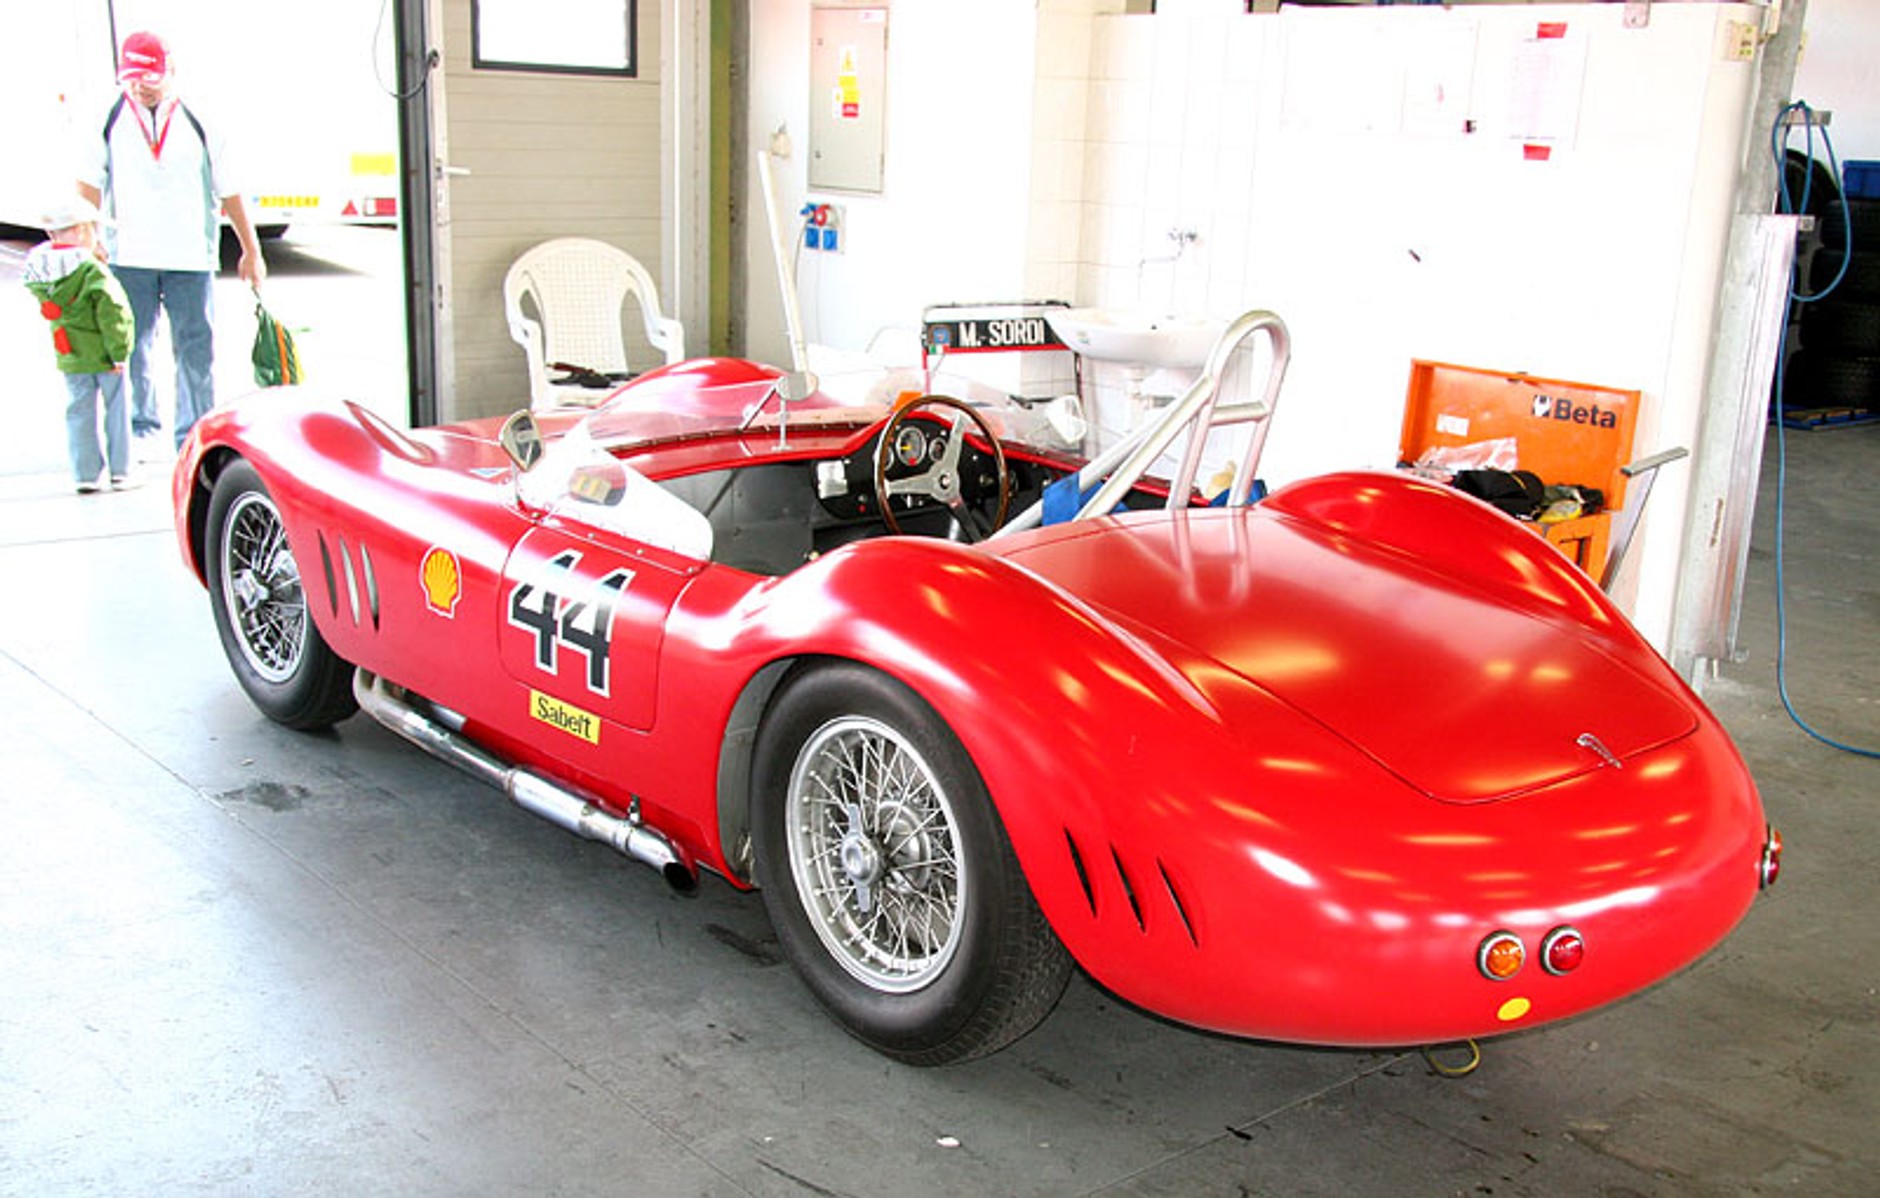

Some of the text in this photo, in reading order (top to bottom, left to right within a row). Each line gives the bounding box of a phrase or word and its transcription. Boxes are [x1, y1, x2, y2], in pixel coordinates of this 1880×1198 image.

[989, 320, 1045, 345] SORDI
[1554, 398, 1616, 428] Beta
[509, 549, 635, 697] 44
